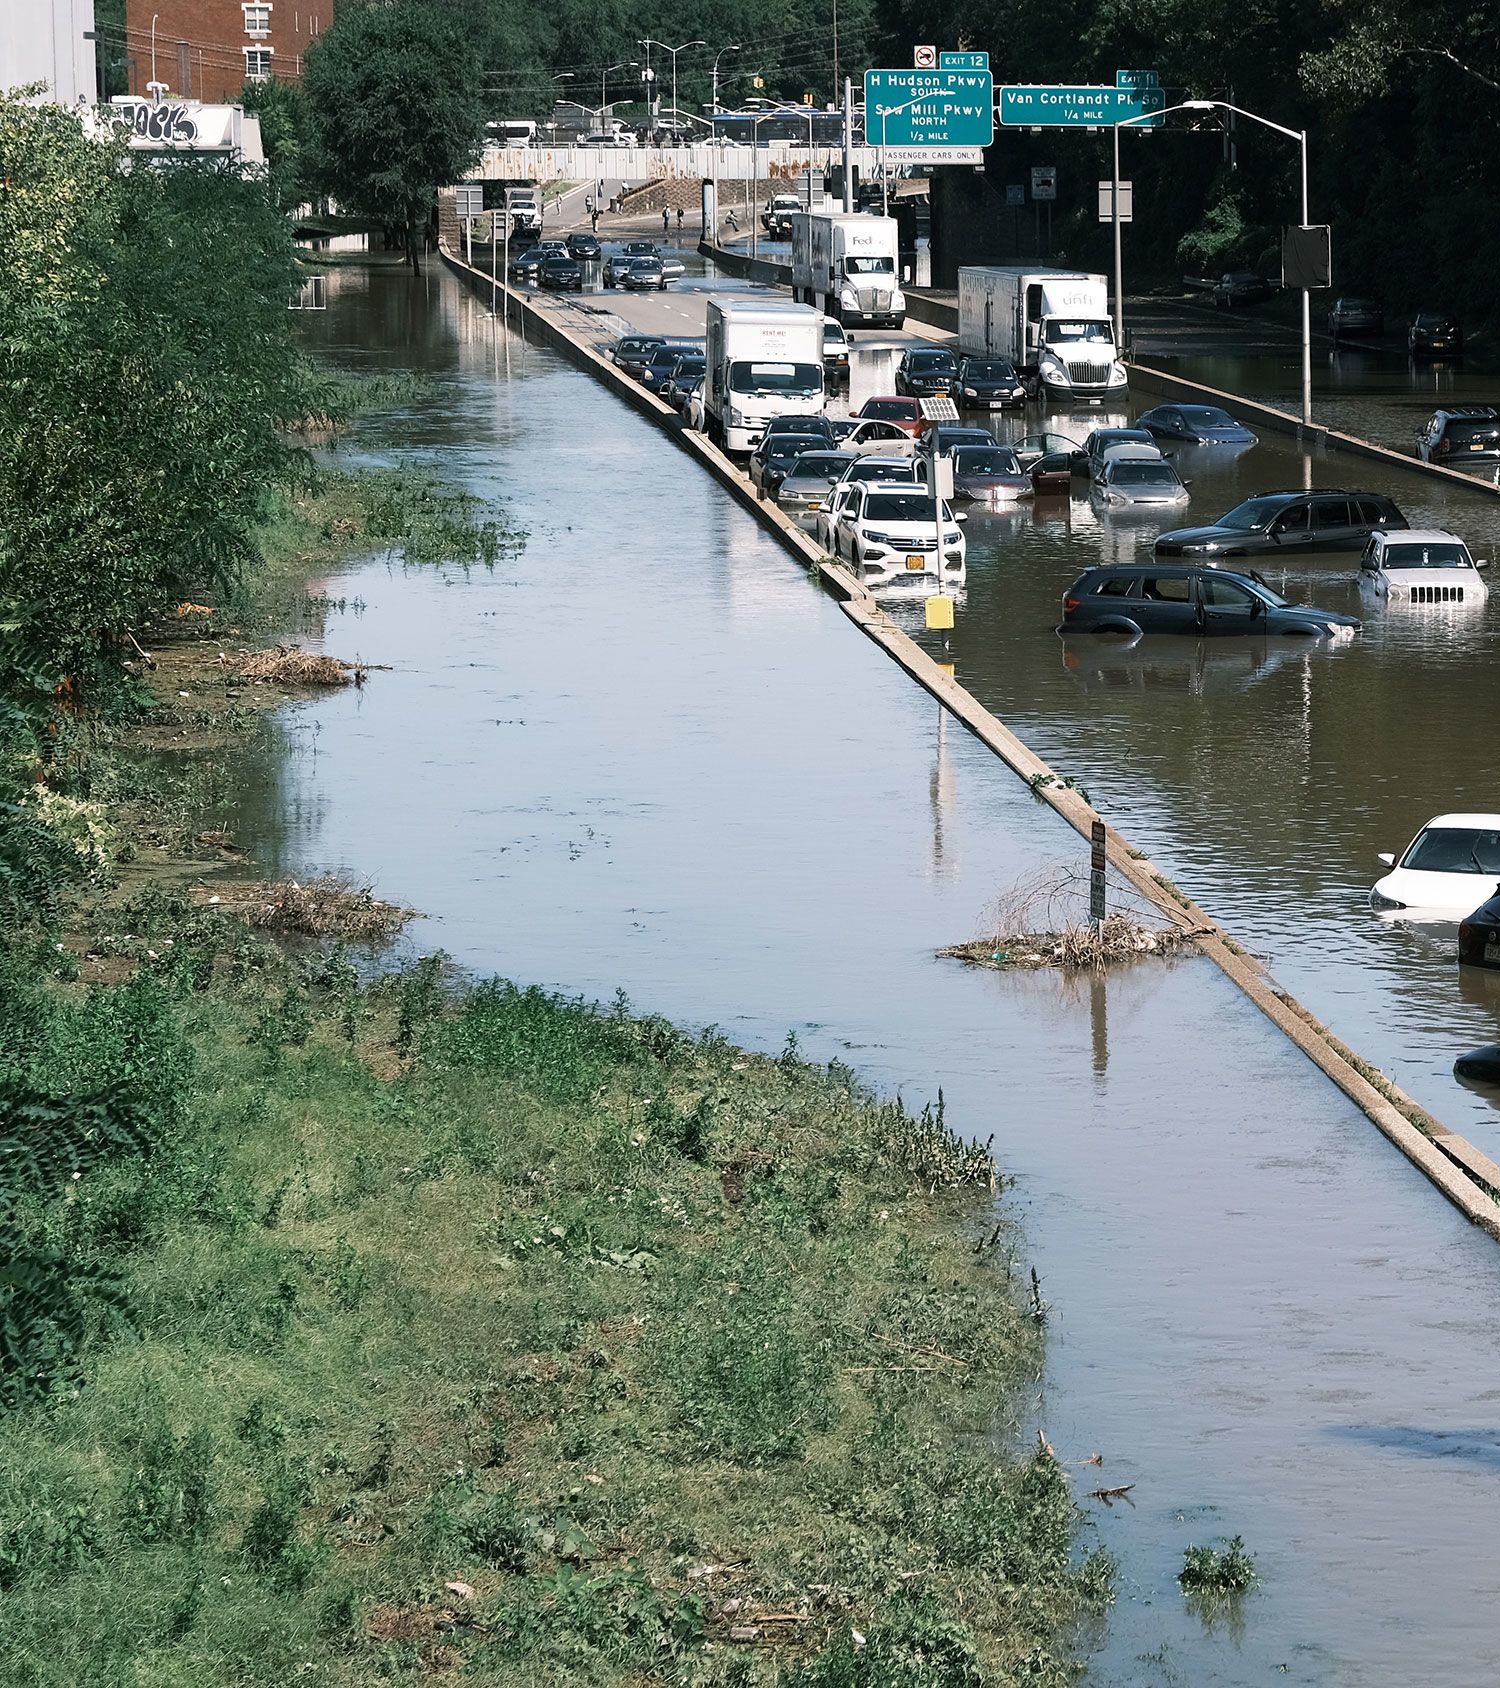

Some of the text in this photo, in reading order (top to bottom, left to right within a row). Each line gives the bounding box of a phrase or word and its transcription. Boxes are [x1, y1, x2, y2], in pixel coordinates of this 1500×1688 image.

[945, 56, 984, 67] EXIT 12
[871, 75, 986, 89] H Hudson Pkwy
[1007, 93, 1033, 105] Van
[1040, 93, 1110, 105] Cortlandt
[1117, 94, 1134, 105] Pk
[911, 104, 936, 116] Mill
[943, 104, 983, 118] Pkwy
[1064, 109, 1103, 120] 1/4 MILE
[911, 117, 947, 126] NORTH
[910, 131, 924, 141] 1/2
[884, 151, 976, 160] ASSENGER CARS ONLY
